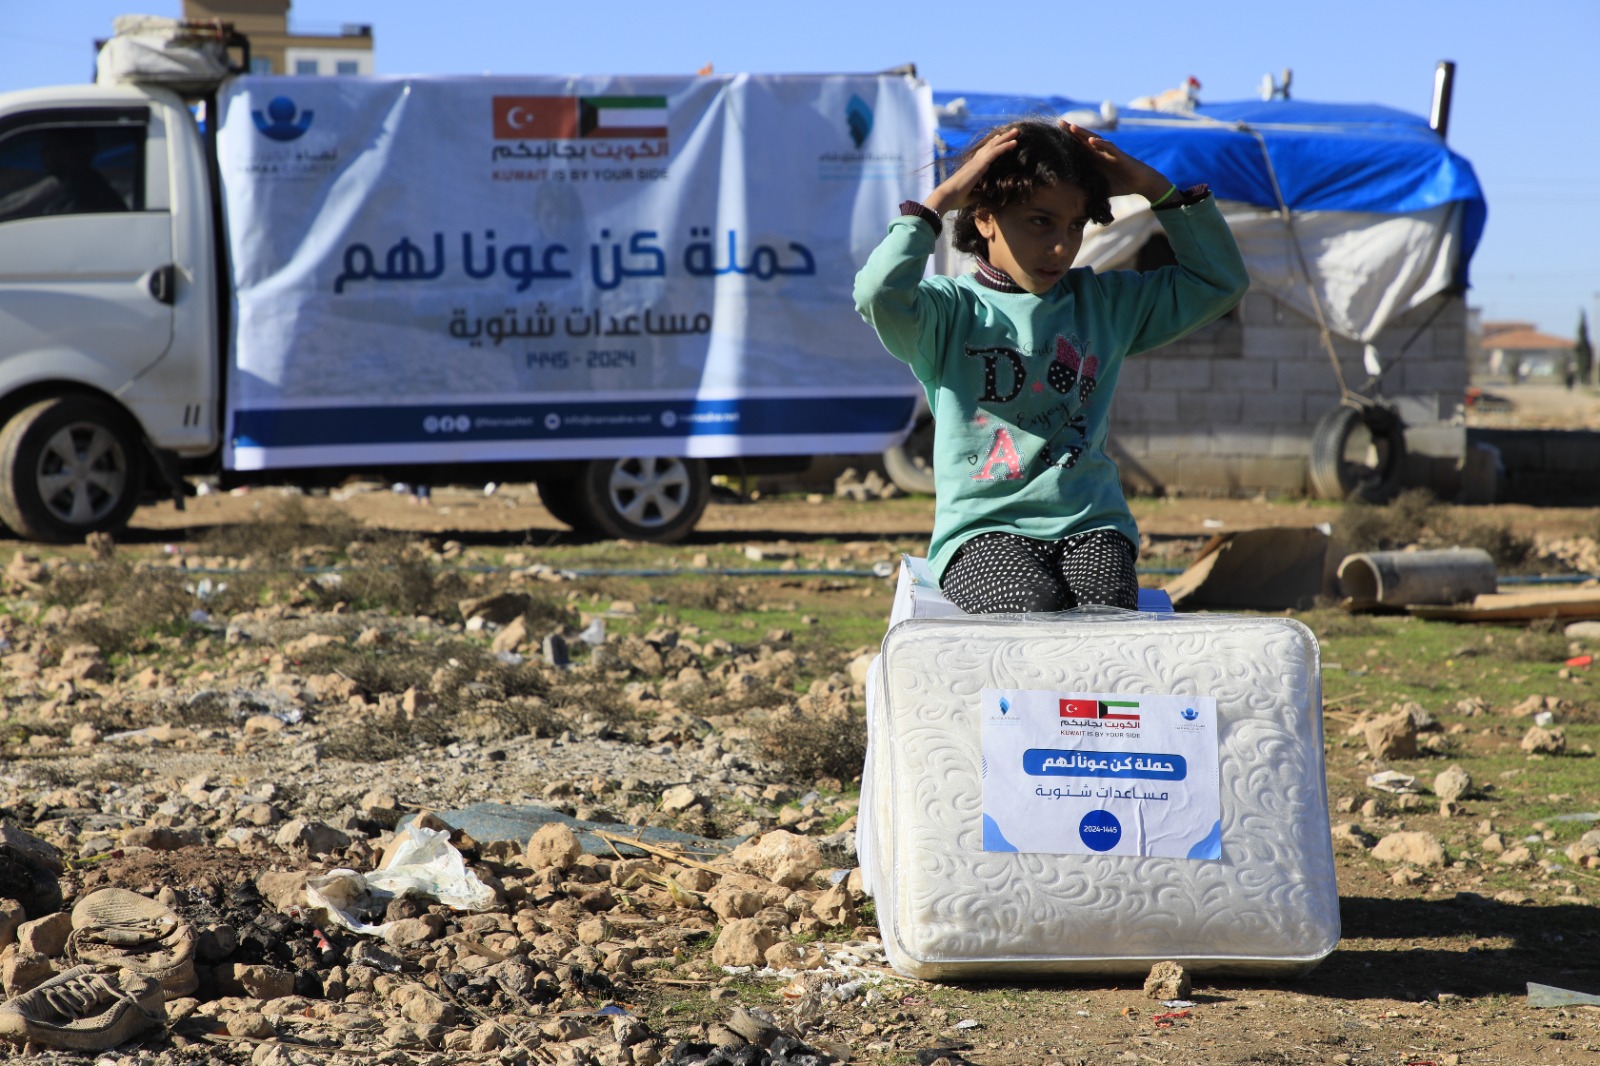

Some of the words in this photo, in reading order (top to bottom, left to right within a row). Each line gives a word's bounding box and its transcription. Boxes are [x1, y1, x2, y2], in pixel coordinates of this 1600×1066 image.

[491, 141, 587, 163] بجانبكم
[592, 140, 669, 162] الكويت
[492, 169, 547, 181] KUWAIT
[552, 169, 566, 181] IS
[570, 169, 589, 181] BY
[594, 168, 633, 181] YOUR
[638, 168, 669, 180] SIDE
[334, 231, 445, 294] لهم
[461, 229, 573, 293] عونا
[589, 228, 666, 291] كن
[684, 227, 816, 281] حملة
[449, 301, 556, 348] شتوية
[565, 307, 713, 339] مساعدات
[525, 351, 571, 369] 1445
[586, 350, 637, 368] 2024
[965, 346, 1027, 403] D
[1016, 402, 1070, 431] Enjoy
[971, 426, 1024, 481] A
[1060, 719, 1103, 729] بجانبكم
[1105, 720, 1140, 730] الكويت
[1042, 755, 1075, 772] لهم
[1110, 756, 1132, 772] كن
[1134, 758, 1175, 773] حملة
[1035, 784, 1092, 800] شتوية
[1096, 786, 1169, 801] مساعدات
[1083, 825, 1118, 834] 2024-1445
